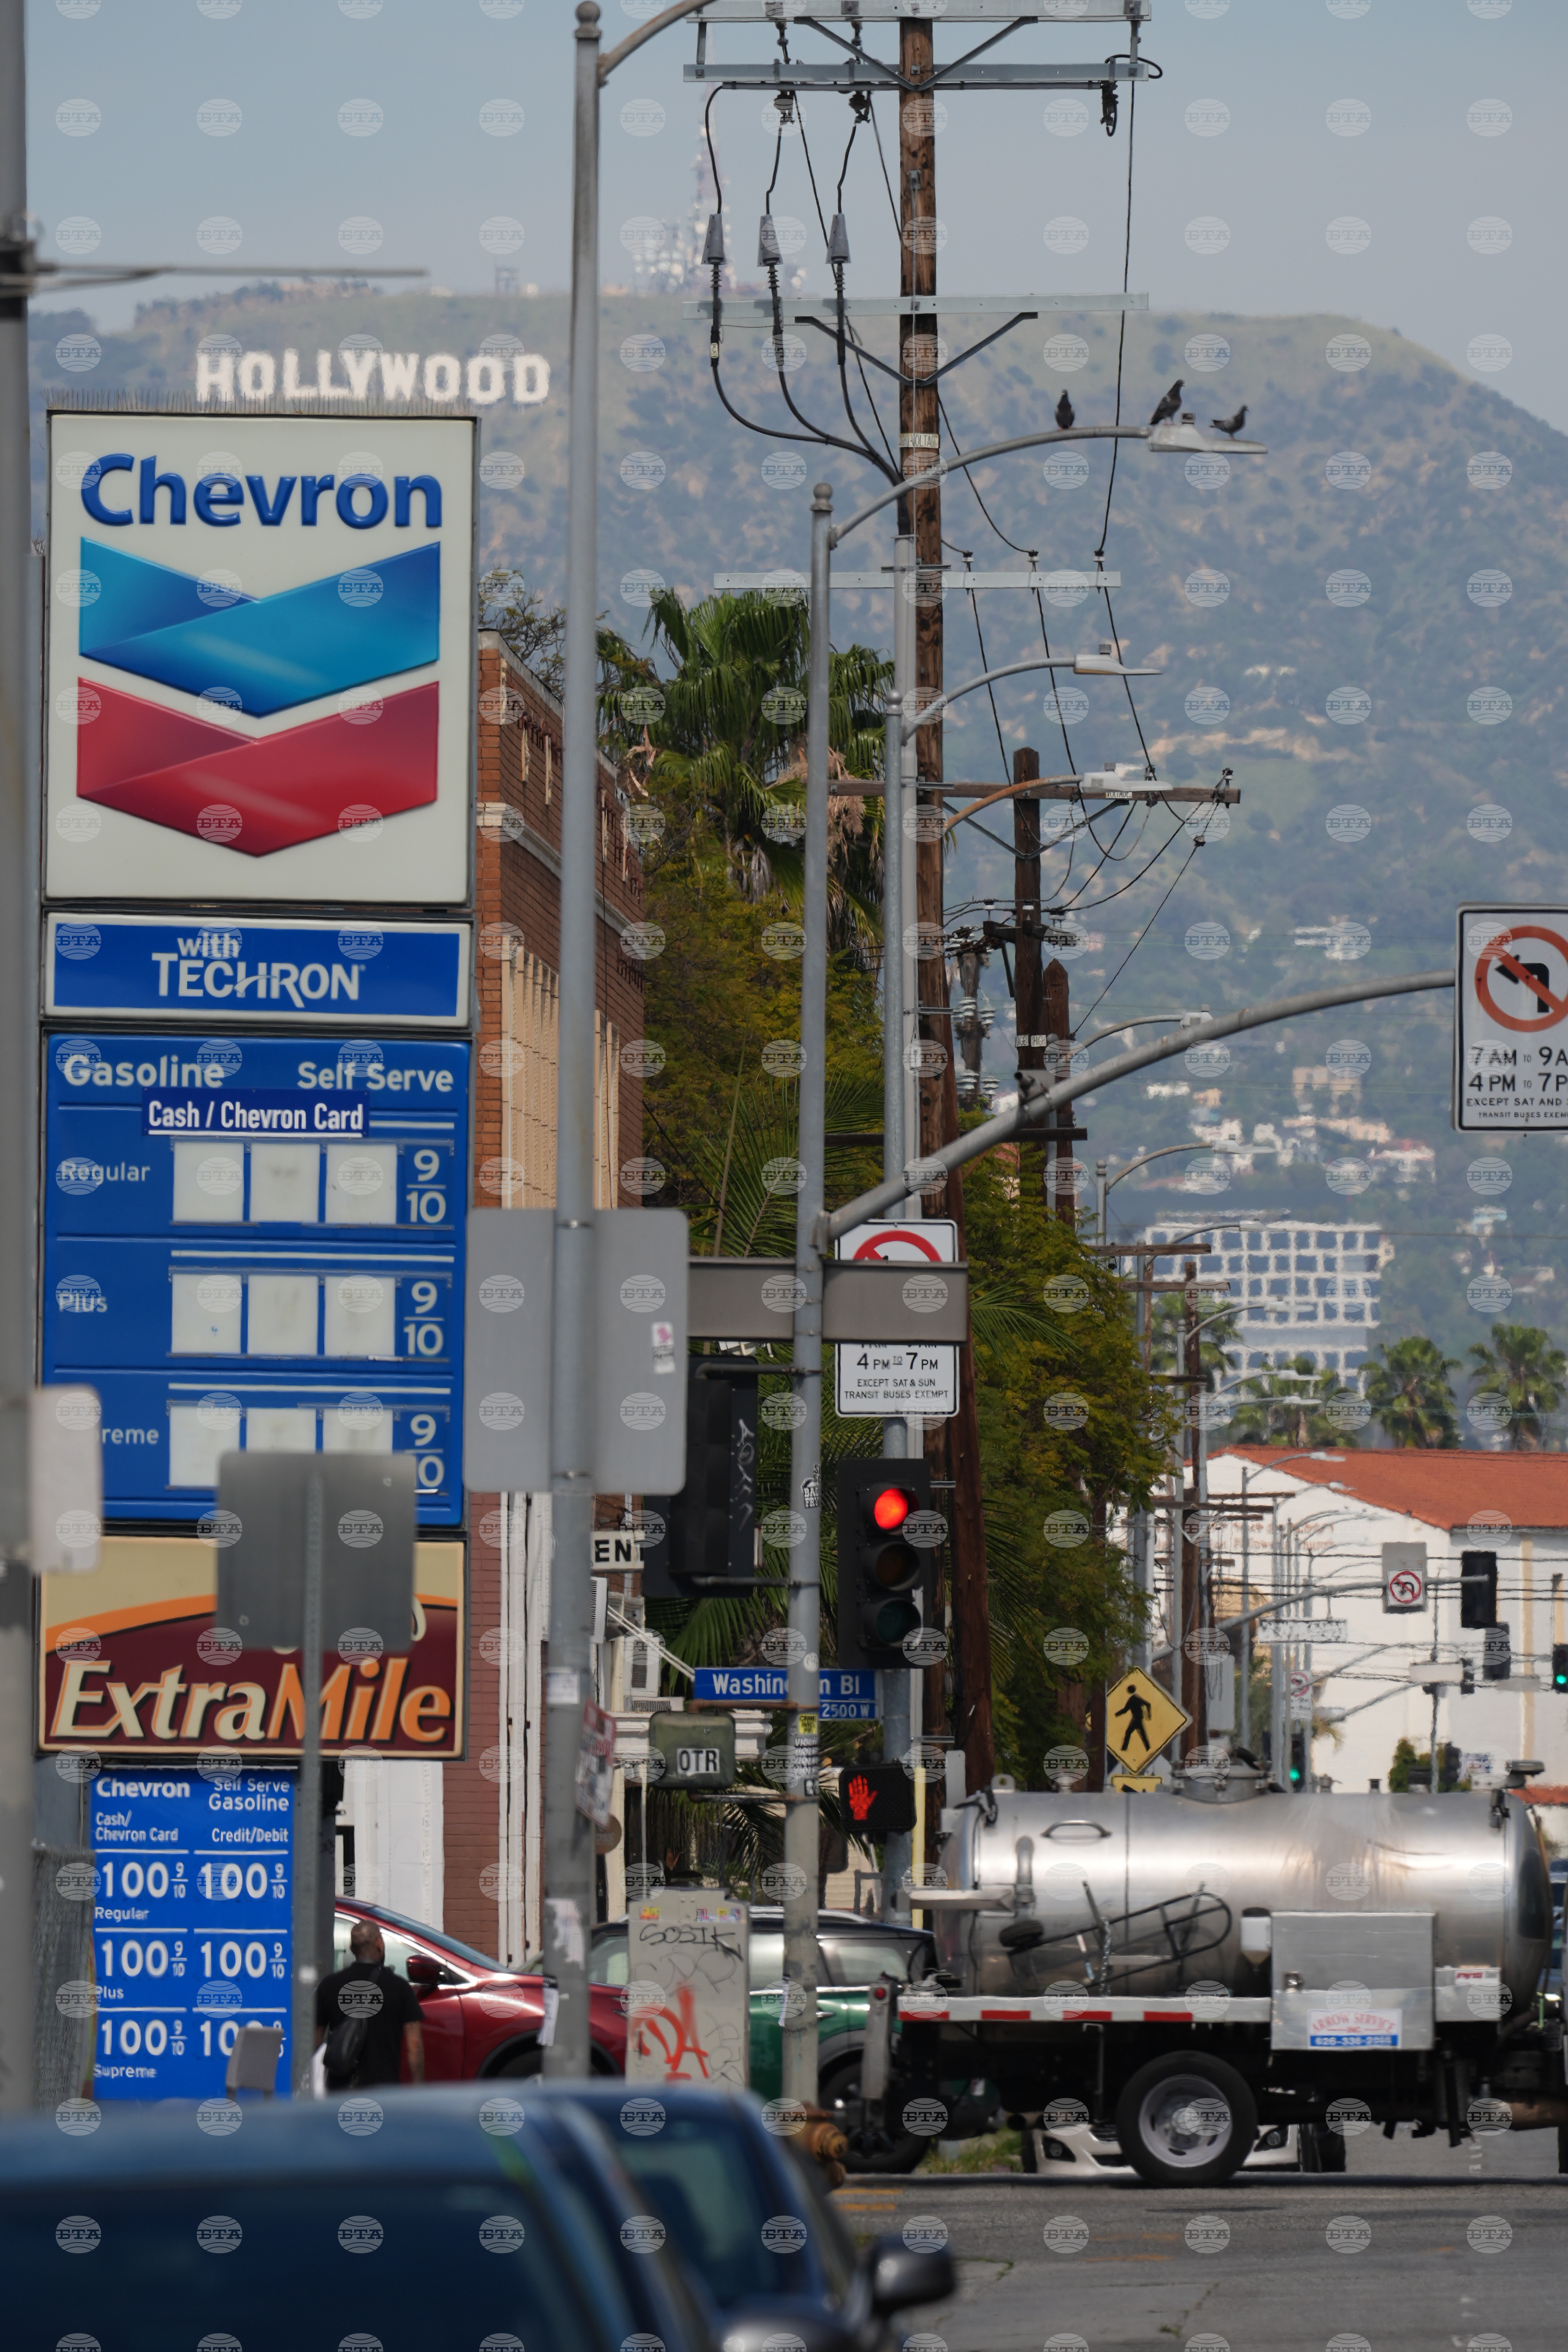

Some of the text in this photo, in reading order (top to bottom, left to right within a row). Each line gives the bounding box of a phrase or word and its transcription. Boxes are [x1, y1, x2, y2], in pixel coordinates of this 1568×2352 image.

[196, 348, 550, 404] HOLLYWOOD
[81, 453, 443, 530] Chevron
[178, 931, 239, 959] with
[152, 953, 360, 1008] TECHRON
[64, 1054, 225, 1088] Gasoline
[298, 1060, 454, 1092] Self Serve
[1466, 1098, 1508, 1107] EXCEPT
[148, 1100, 200, 1128] Cash
[220, 1101, 307, 1130] Chevron
[314, 1103, 364, 1131] Card
[60, 1161, 151, 1185] Regular
[413, 1149, 441, 1182] 9
[405, 1191, 446, 1223] 10
[57, 1292, 108, 1314] Plus
[411, 1281, 437, 1314] 9
[403, 1323, 444, 1356] 10
[857, 1379, 889, 1387] EXCEPT
[893, 1379, 908, 1387] SAT
[918, 1378, 936, 1387] SUN
[844, 1391, 880, 1399] TRANSIT
[915, 1390, 949, 1399] EXEMPT
[100, 1428, 160, 1445] reme
[410, 1414, 437, 1446] 9
[415, 1456, 445, 1488] 0
[713, 1673, 831, 1695] Washinn
[50, 1657, 452, 1744] ExtraMile
[822, 1704, 857, 1718] 2500
[679, 1749, 718, 1771] OTR
[96, 1777, 191, 1798] Chevron
[214, 1778, 290, 1793] Self Serve
[209, 1794, 290, 1812] Gasoline
[96, 1809, 132, 1826] Cash/
[95, 1827, 178, 1842] Chevron Card
[212, 1826, 289, 1844] Credit/Debit
[94, 1907, 150, 1922] Regular
[1312, 2013, 1349, 2032] ARROW
[200, 2020, 263, 2057] 10
[93, 2063, 157, 2079] Supreme
